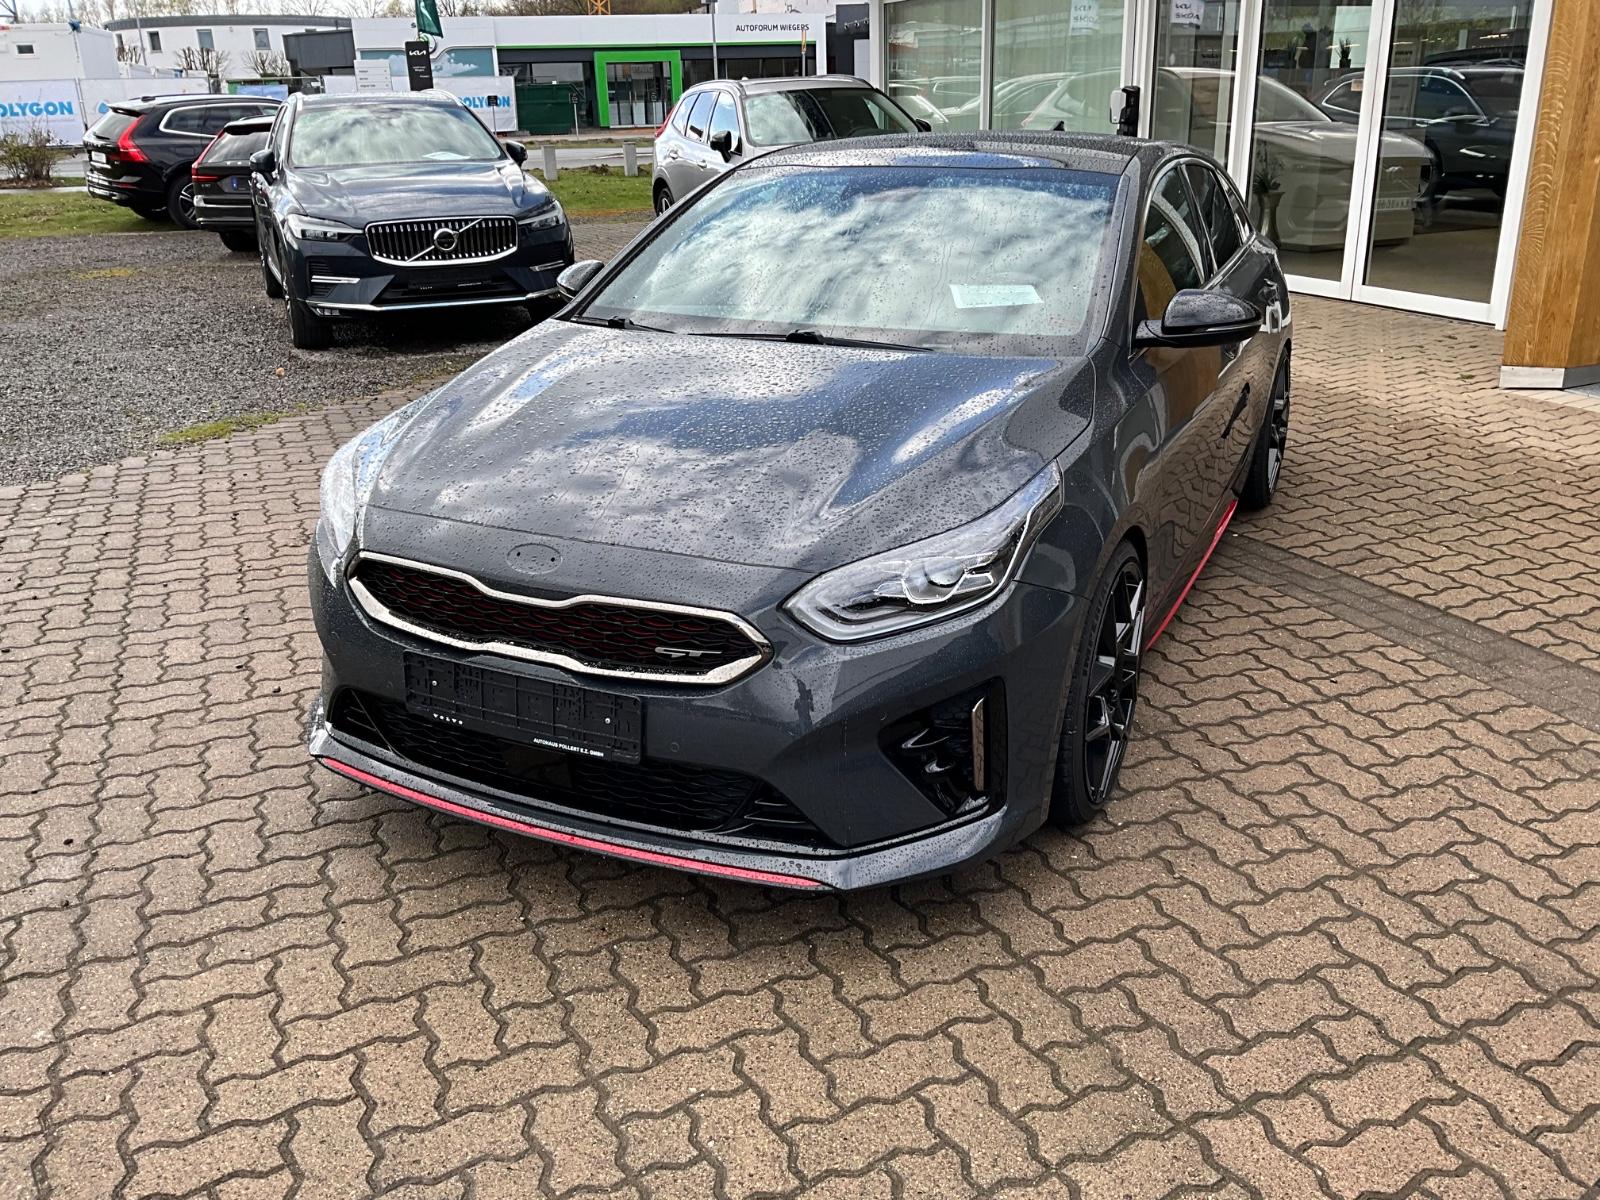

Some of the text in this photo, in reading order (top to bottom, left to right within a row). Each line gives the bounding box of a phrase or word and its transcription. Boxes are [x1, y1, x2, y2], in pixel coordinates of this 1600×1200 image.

[736, 23, 810, 32] AUTOFORUM WIEGERS
[460, 95, 510, 109] OLYON
[533, 738, 559, 748] AUTOHAUS
[558, 743, 580, 752] POLLERT
